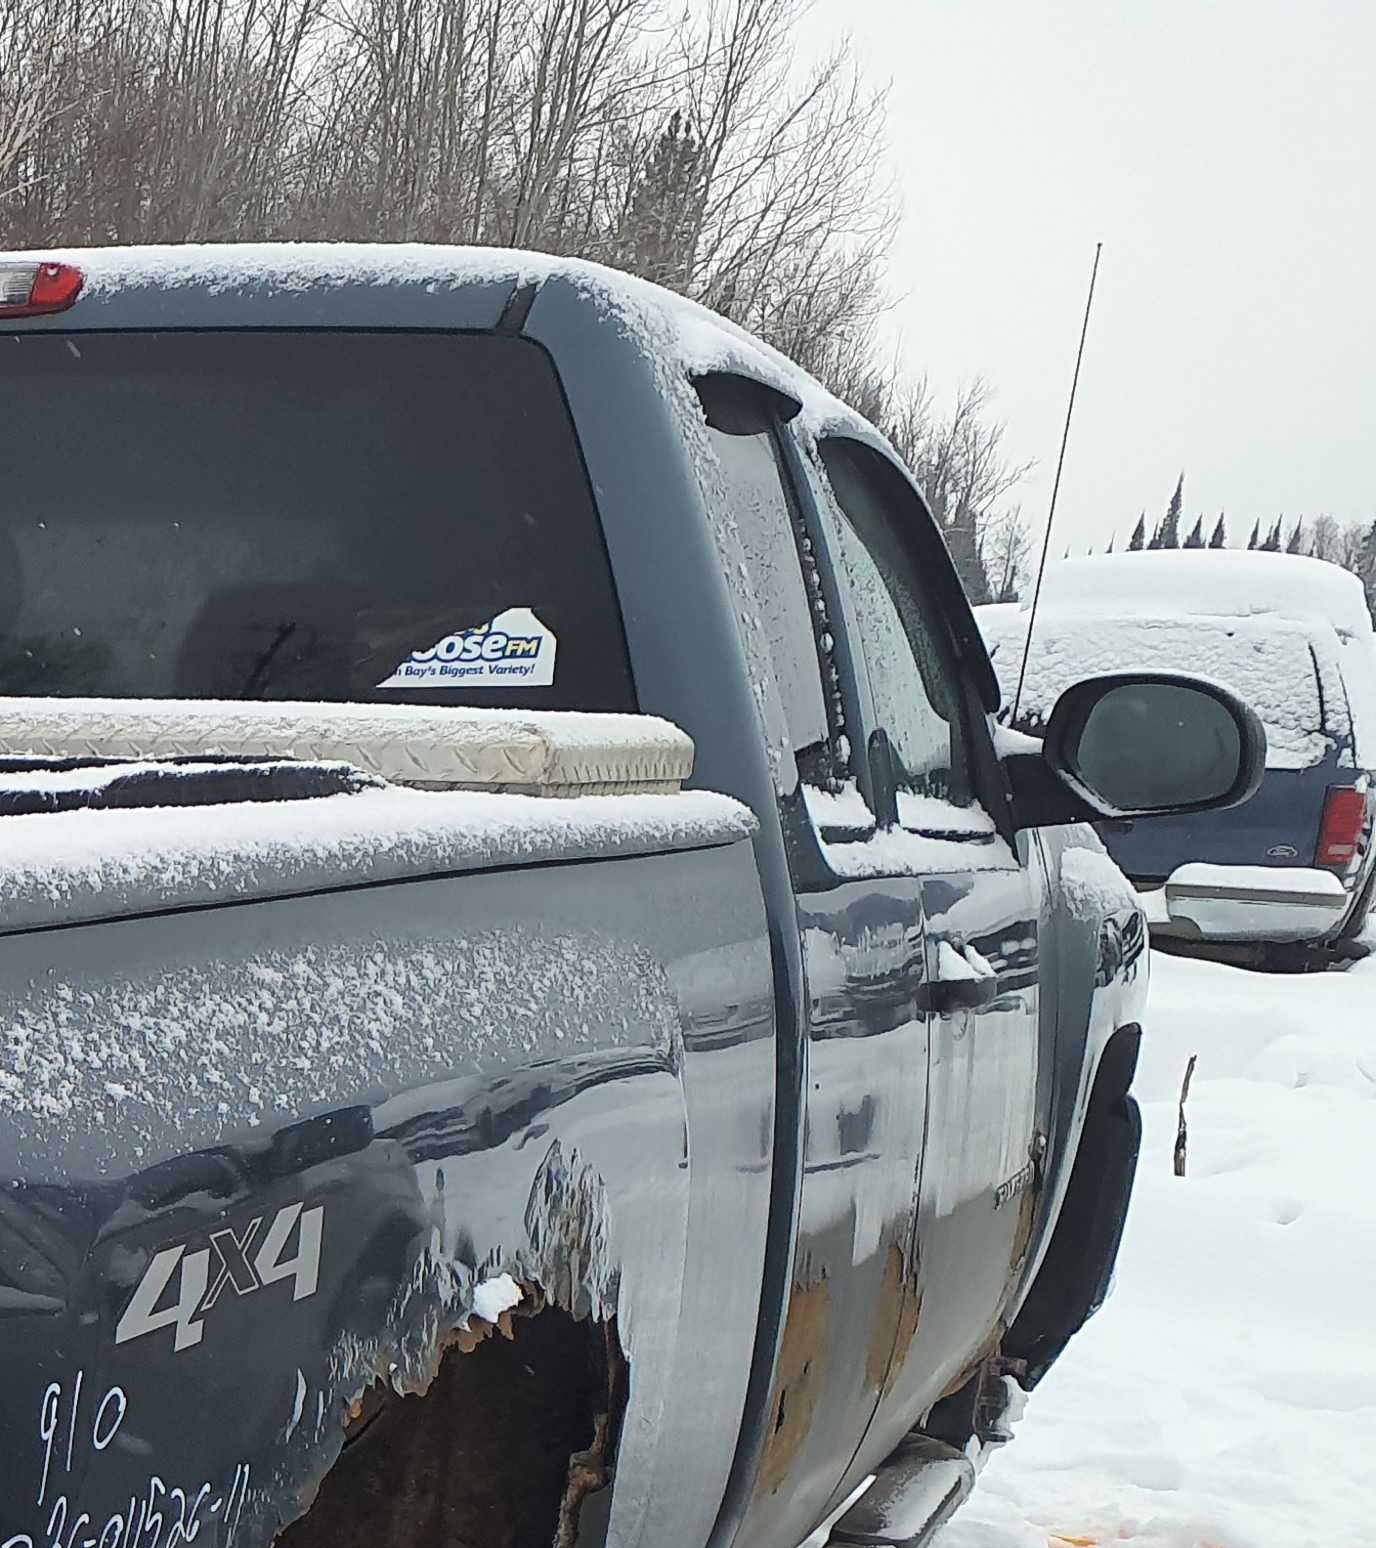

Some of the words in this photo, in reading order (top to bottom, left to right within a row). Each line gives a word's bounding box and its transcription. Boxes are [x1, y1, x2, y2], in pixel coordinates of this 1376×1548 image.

[405, 664, 436, 679] Bay's
[439, 665, 484, 678] Biggest
[488, 663, 536, 677] Variety!
[37, 1370, 127, 1506] 910
